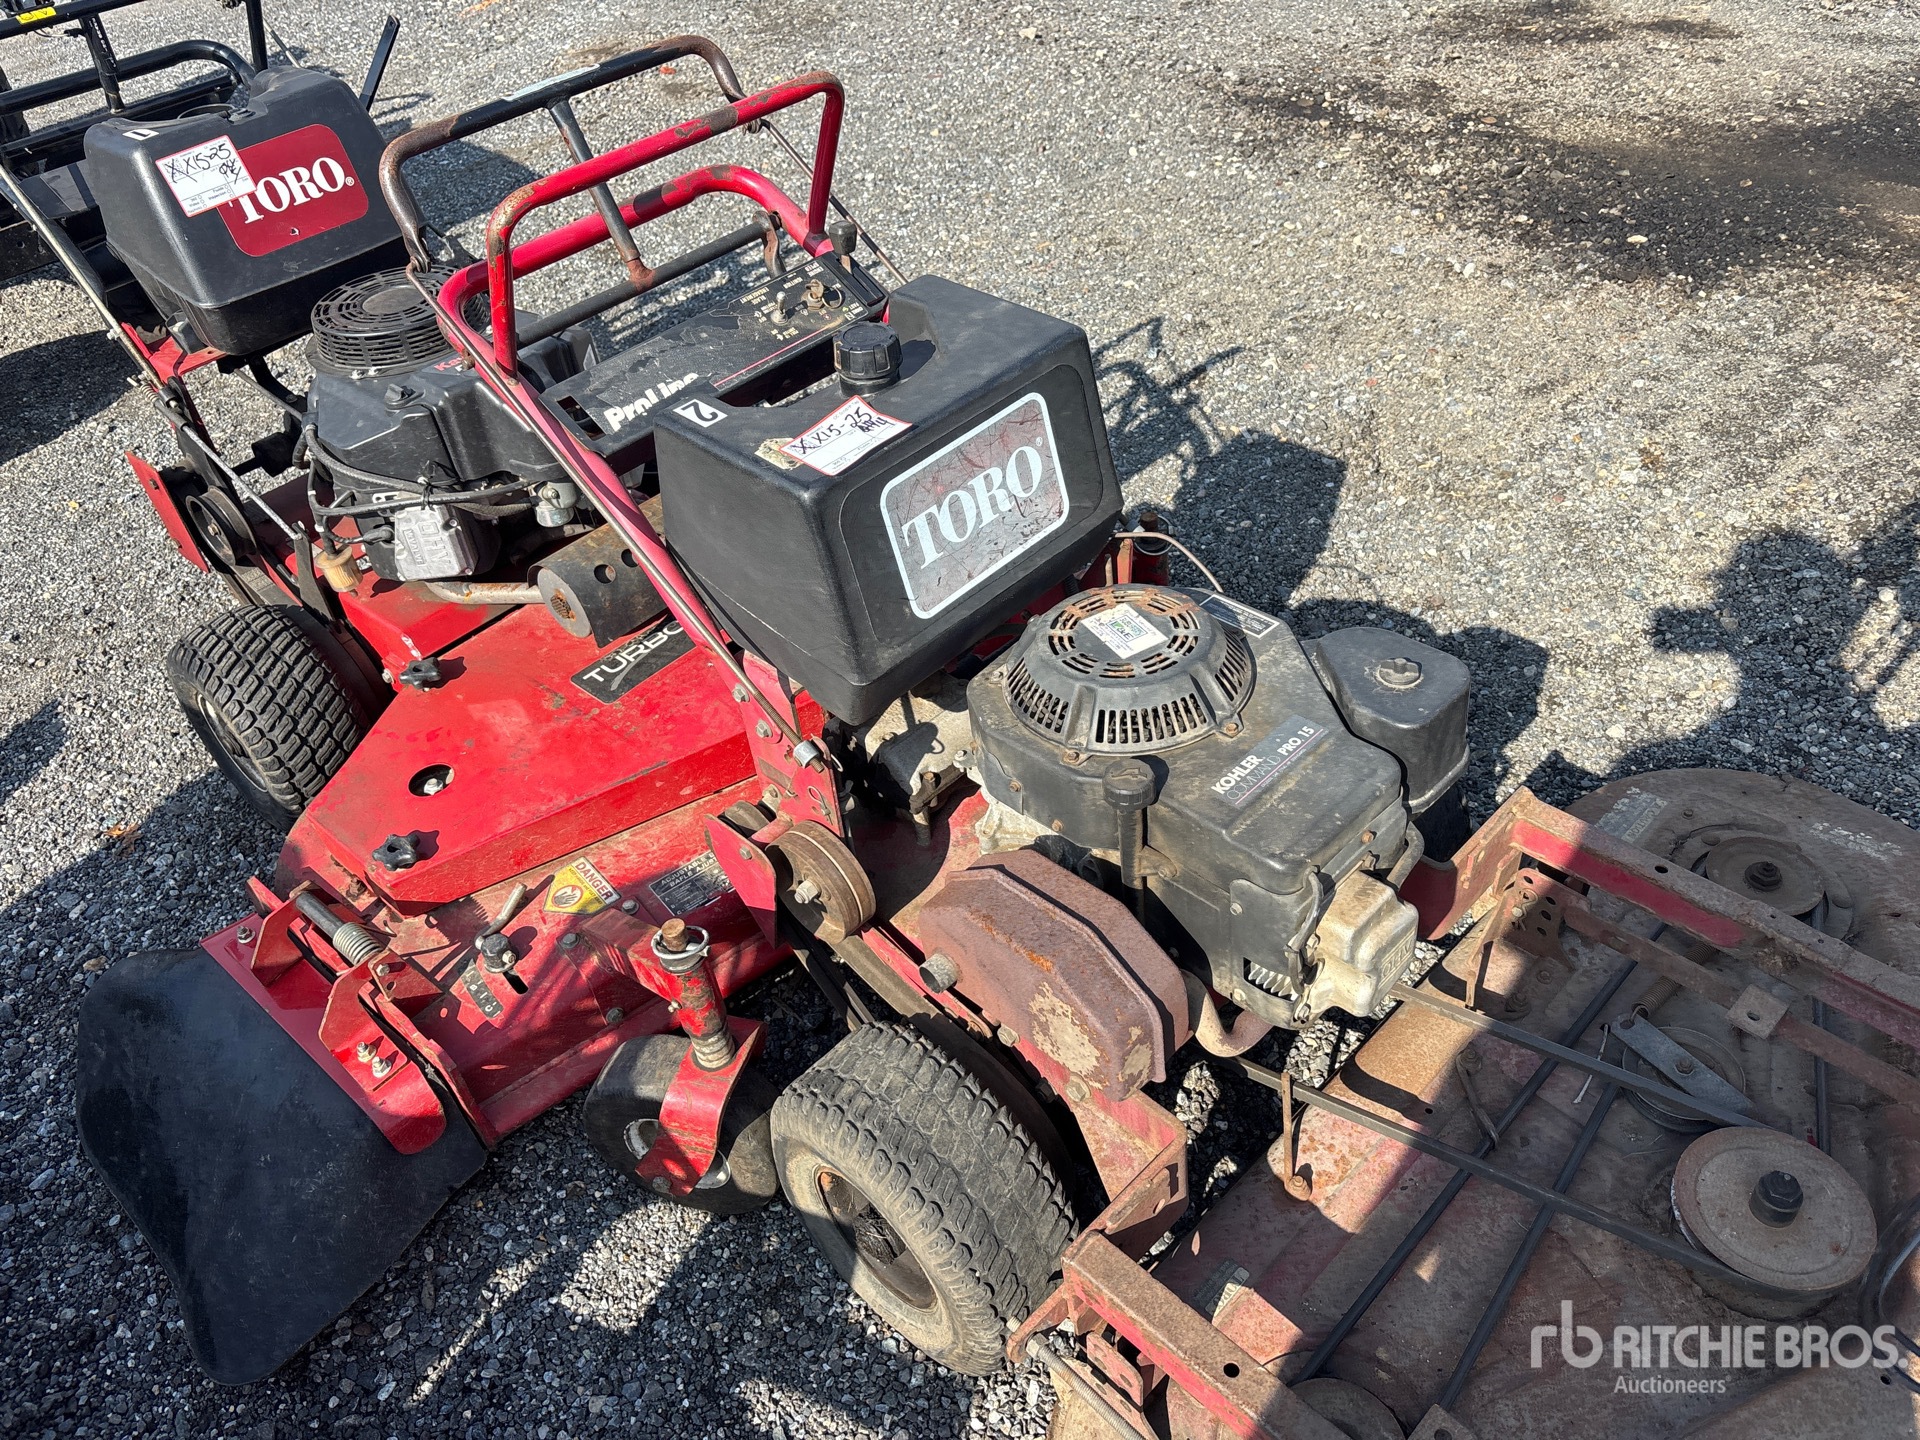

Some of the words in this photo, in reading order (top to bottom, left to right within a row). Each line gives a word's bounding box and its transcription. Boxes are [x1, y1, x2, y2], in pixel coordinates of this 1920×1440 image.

[739, 286, 769, 304] ENGAGEMENT
[681, 402, 719, 422] 2
[901, 446, 1044, 570] TORO
[583, 621, 684, 682] TURBO
[1211, 755, 1265, 794] KOHLER
[1227, 756, 1281, 800] COMMAND
[1277, 737, 1302, 756] PRO
[1298, 726, 1315, 737] 15
[576, 862, 614, 900] DANGER
[661, 856, 706, 885] ADJUSTABLE
[670, 871, 693, 887] BAFLE
